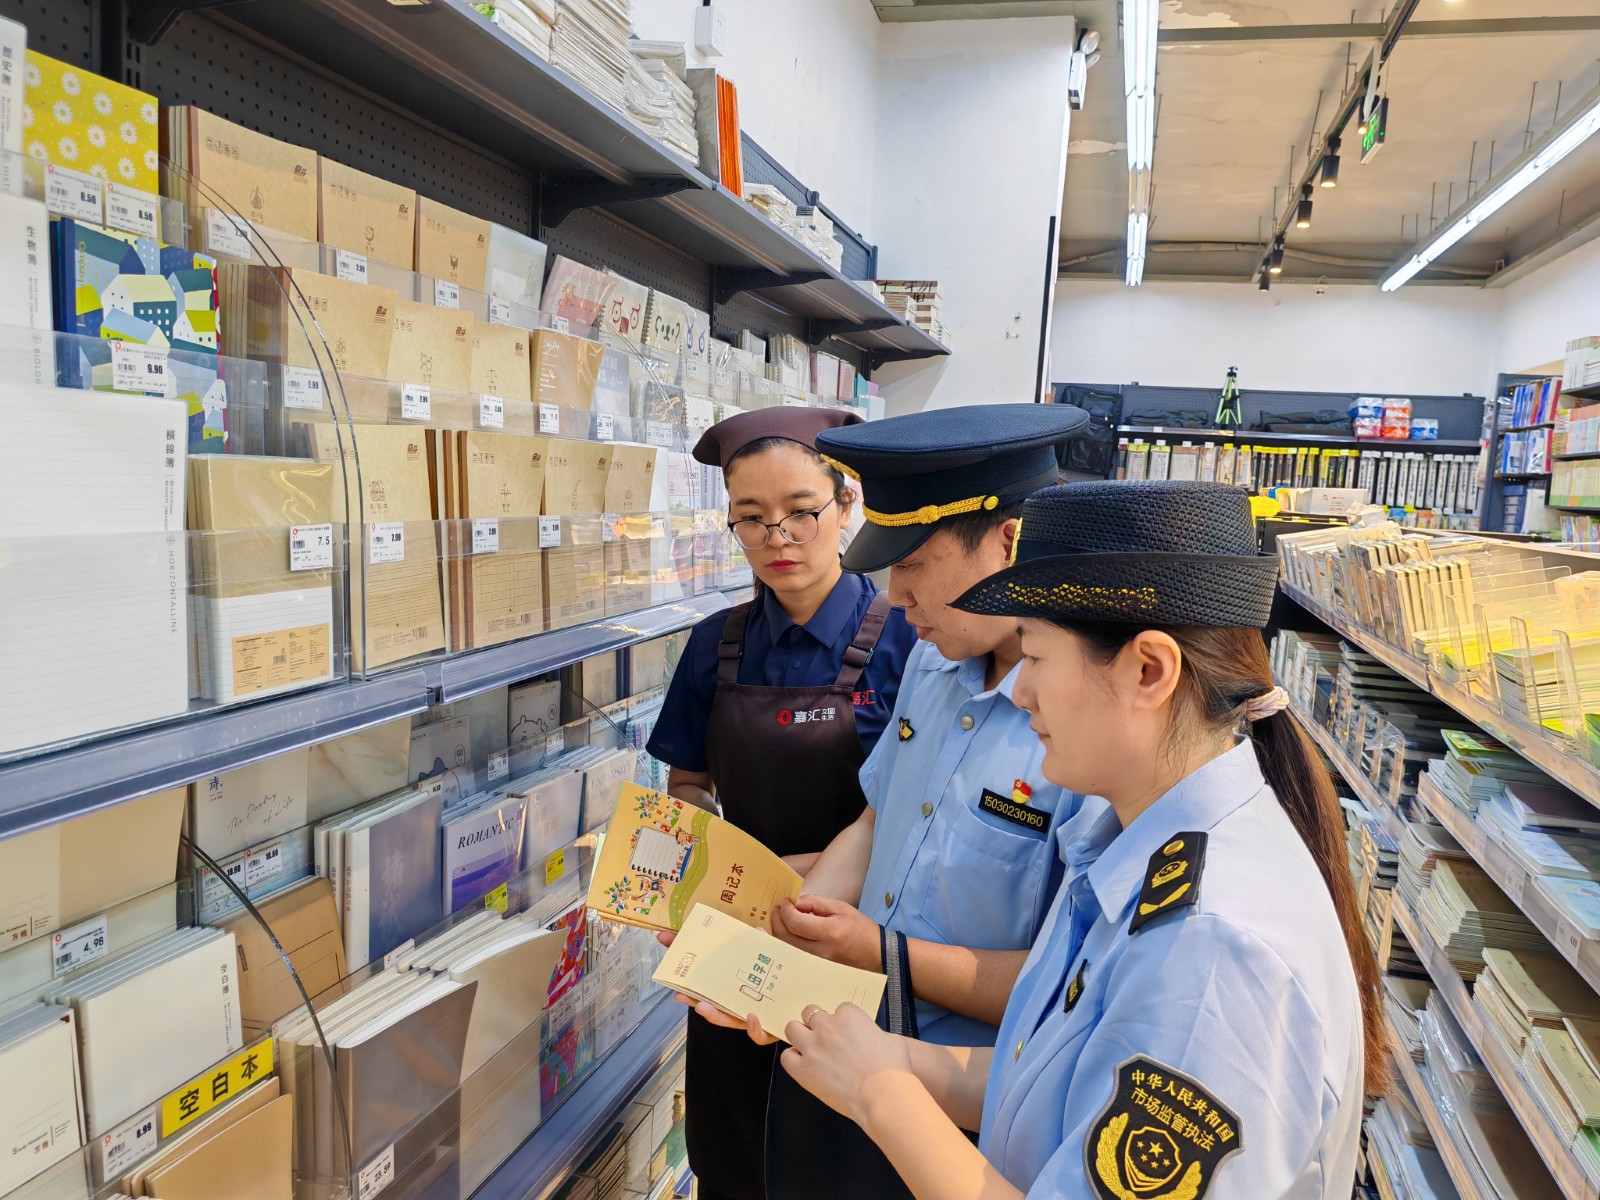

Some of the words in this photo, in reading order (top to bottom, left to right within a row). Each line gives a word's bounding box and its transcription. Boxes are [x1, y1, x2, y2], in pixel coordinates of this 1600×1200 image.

[80, 191, 97, 205] 8.50
[138, 209, 153, 222] 8.50
[147, 363, 163, 375] 9.90
[307, 380, 319, 390] 2.99
[318, 536, 330, 547] 7.5
[391, 532, 402, 542] 2.99
[793, 709, 821, 724] 嘉汇
[984, 795, 1044, 827] 15030230160
[720, 862, 745, 904] 周记本
[83, 936, 104, 952] 4.98
[747, 952, 772, 987] 田字格
[180, 1054, 258, 1121] 空白本
[1131, 1069, 1235, 1143] 中华人民共和国
[1131, 1087, 1216, 1152] 市场监管执法
